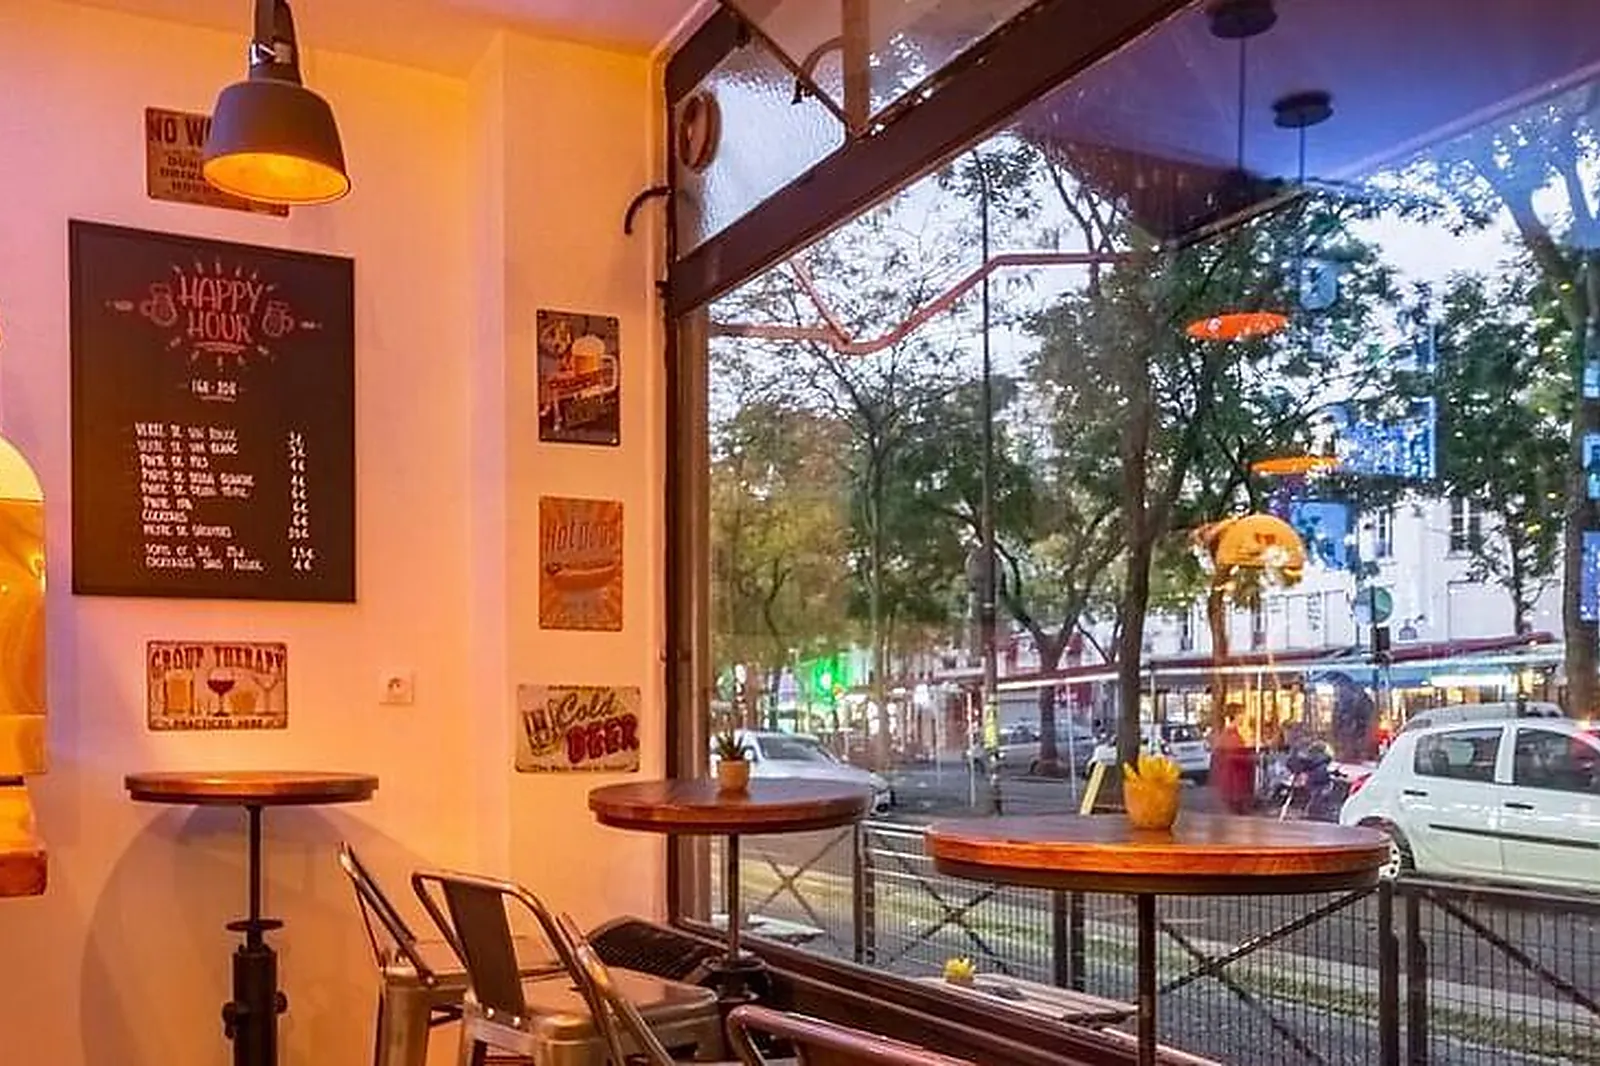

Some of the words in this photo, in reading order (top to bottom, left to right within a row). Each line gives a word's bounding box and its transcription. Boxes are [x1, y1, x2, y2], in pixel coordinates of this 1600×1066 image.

[148, 112, 177, 143] NO
[177, 277, 264, 314] HAPPY
[187, 311, 252, 344] HOUR
[152, 646, 204, 671] GROUP
[214, 646, 284, 674] THERAPY
[559, 692, 616, 725] Cold
[566, 713, 640, 764] BEER
